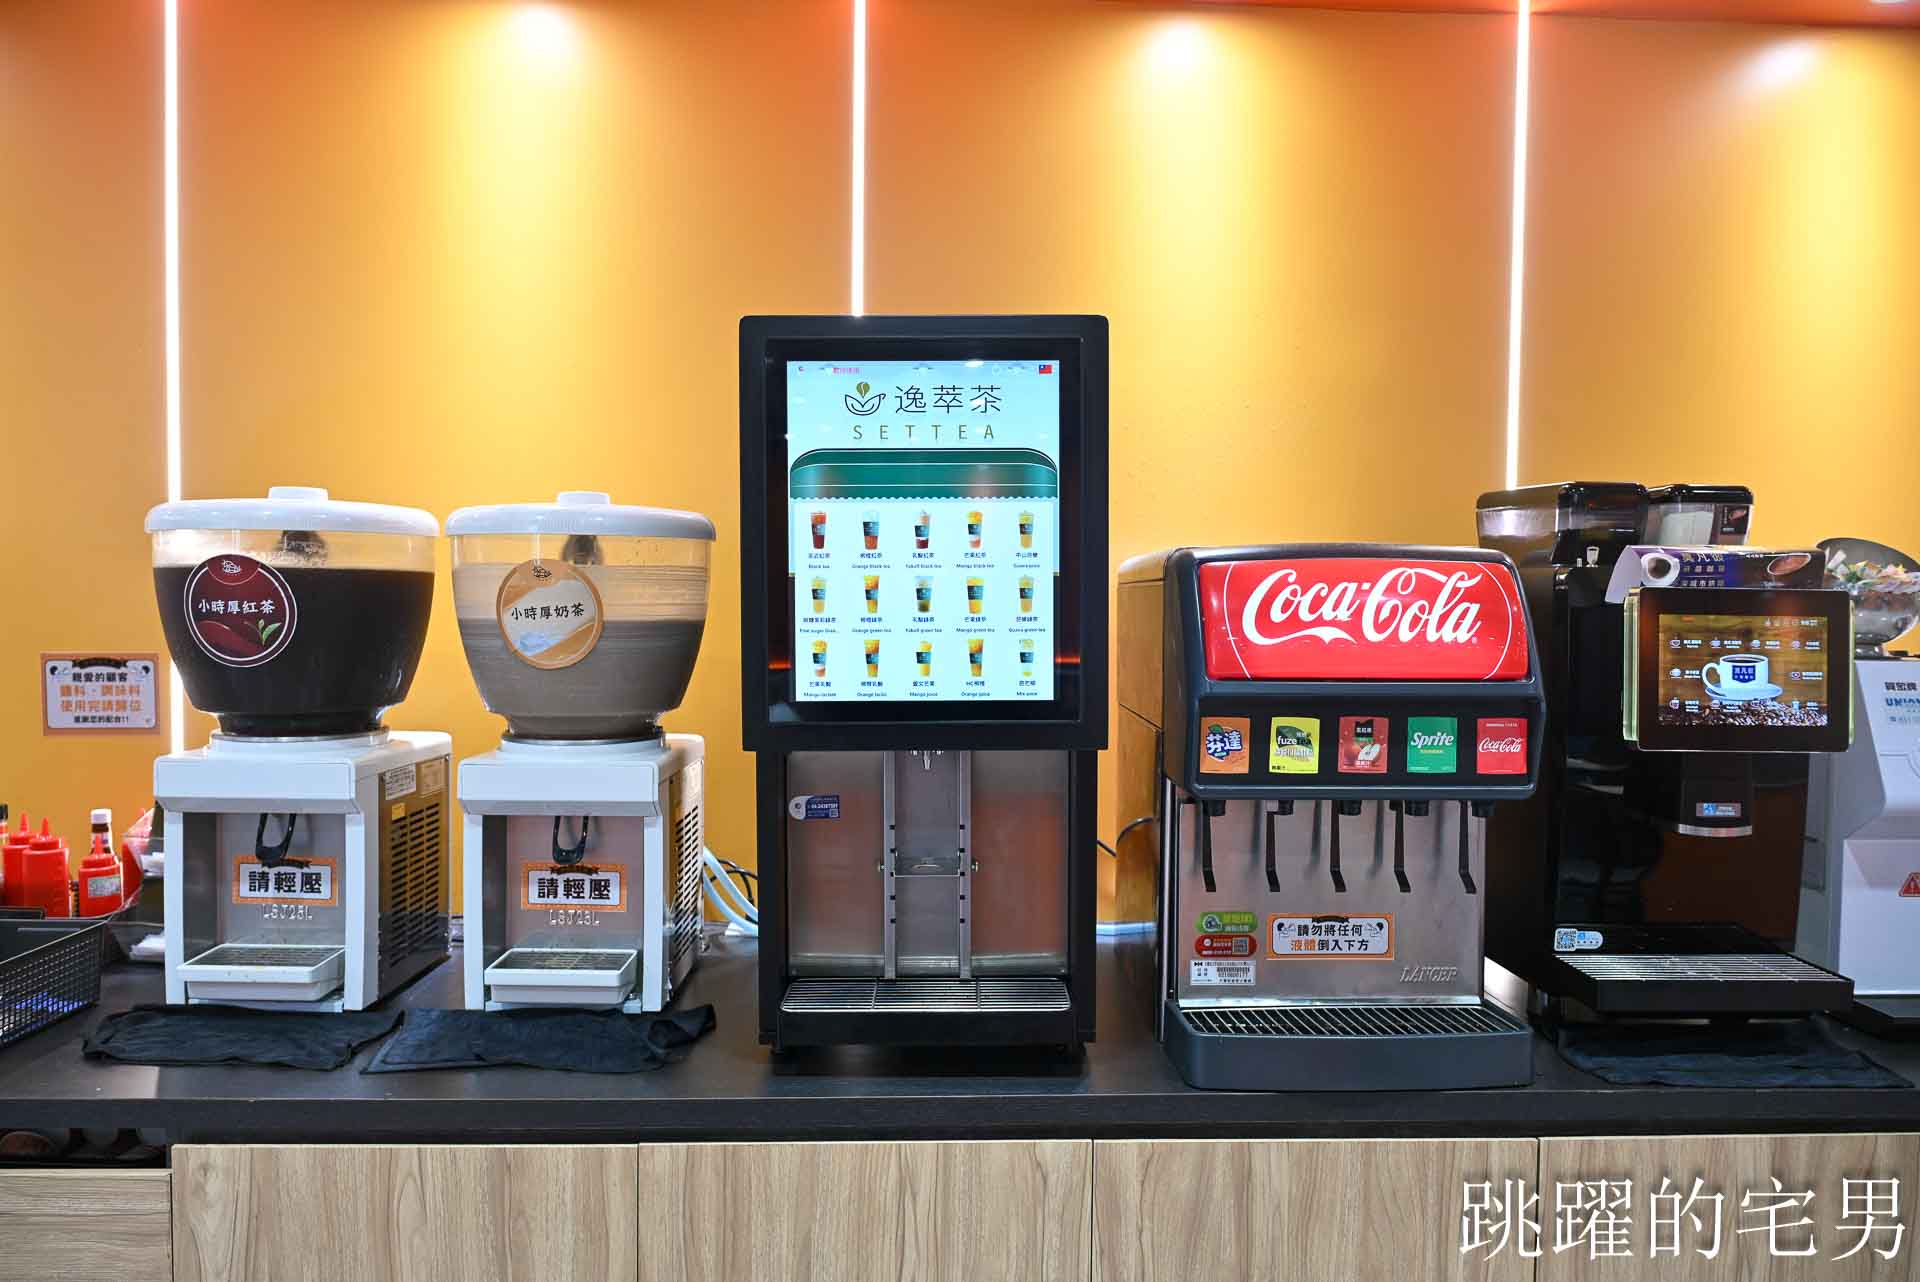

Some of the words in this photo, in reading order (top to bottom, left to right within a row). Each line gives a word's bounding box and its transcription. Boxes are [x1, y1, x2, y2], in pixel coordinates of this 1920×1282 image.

[895, 385, 1002, 414] 逸萃茶
[853, 424, 995, 440] SETTEA
[198, 599, 275, 615] 小時厚紅茶
[511, 602, 585, 620] 小時厚奶茶
[1242, 567, 1482, 645] Coca-Cola
[72, 672, 128, 682] 親愛的顧客
[61, 700, 143, 712] 使用完請歸位
[1411, 732, 1454, 749] Sprite
[1479, 737, 1522, 753] Coca-Cola
[248, 871, 322, 893] 請輕壓
[537, 878, 611, 900] 請輕壓
[1297, 924, 1363, 937] 請勿將任何
[1290, 939, 1369, 952] 液體倒入下方
